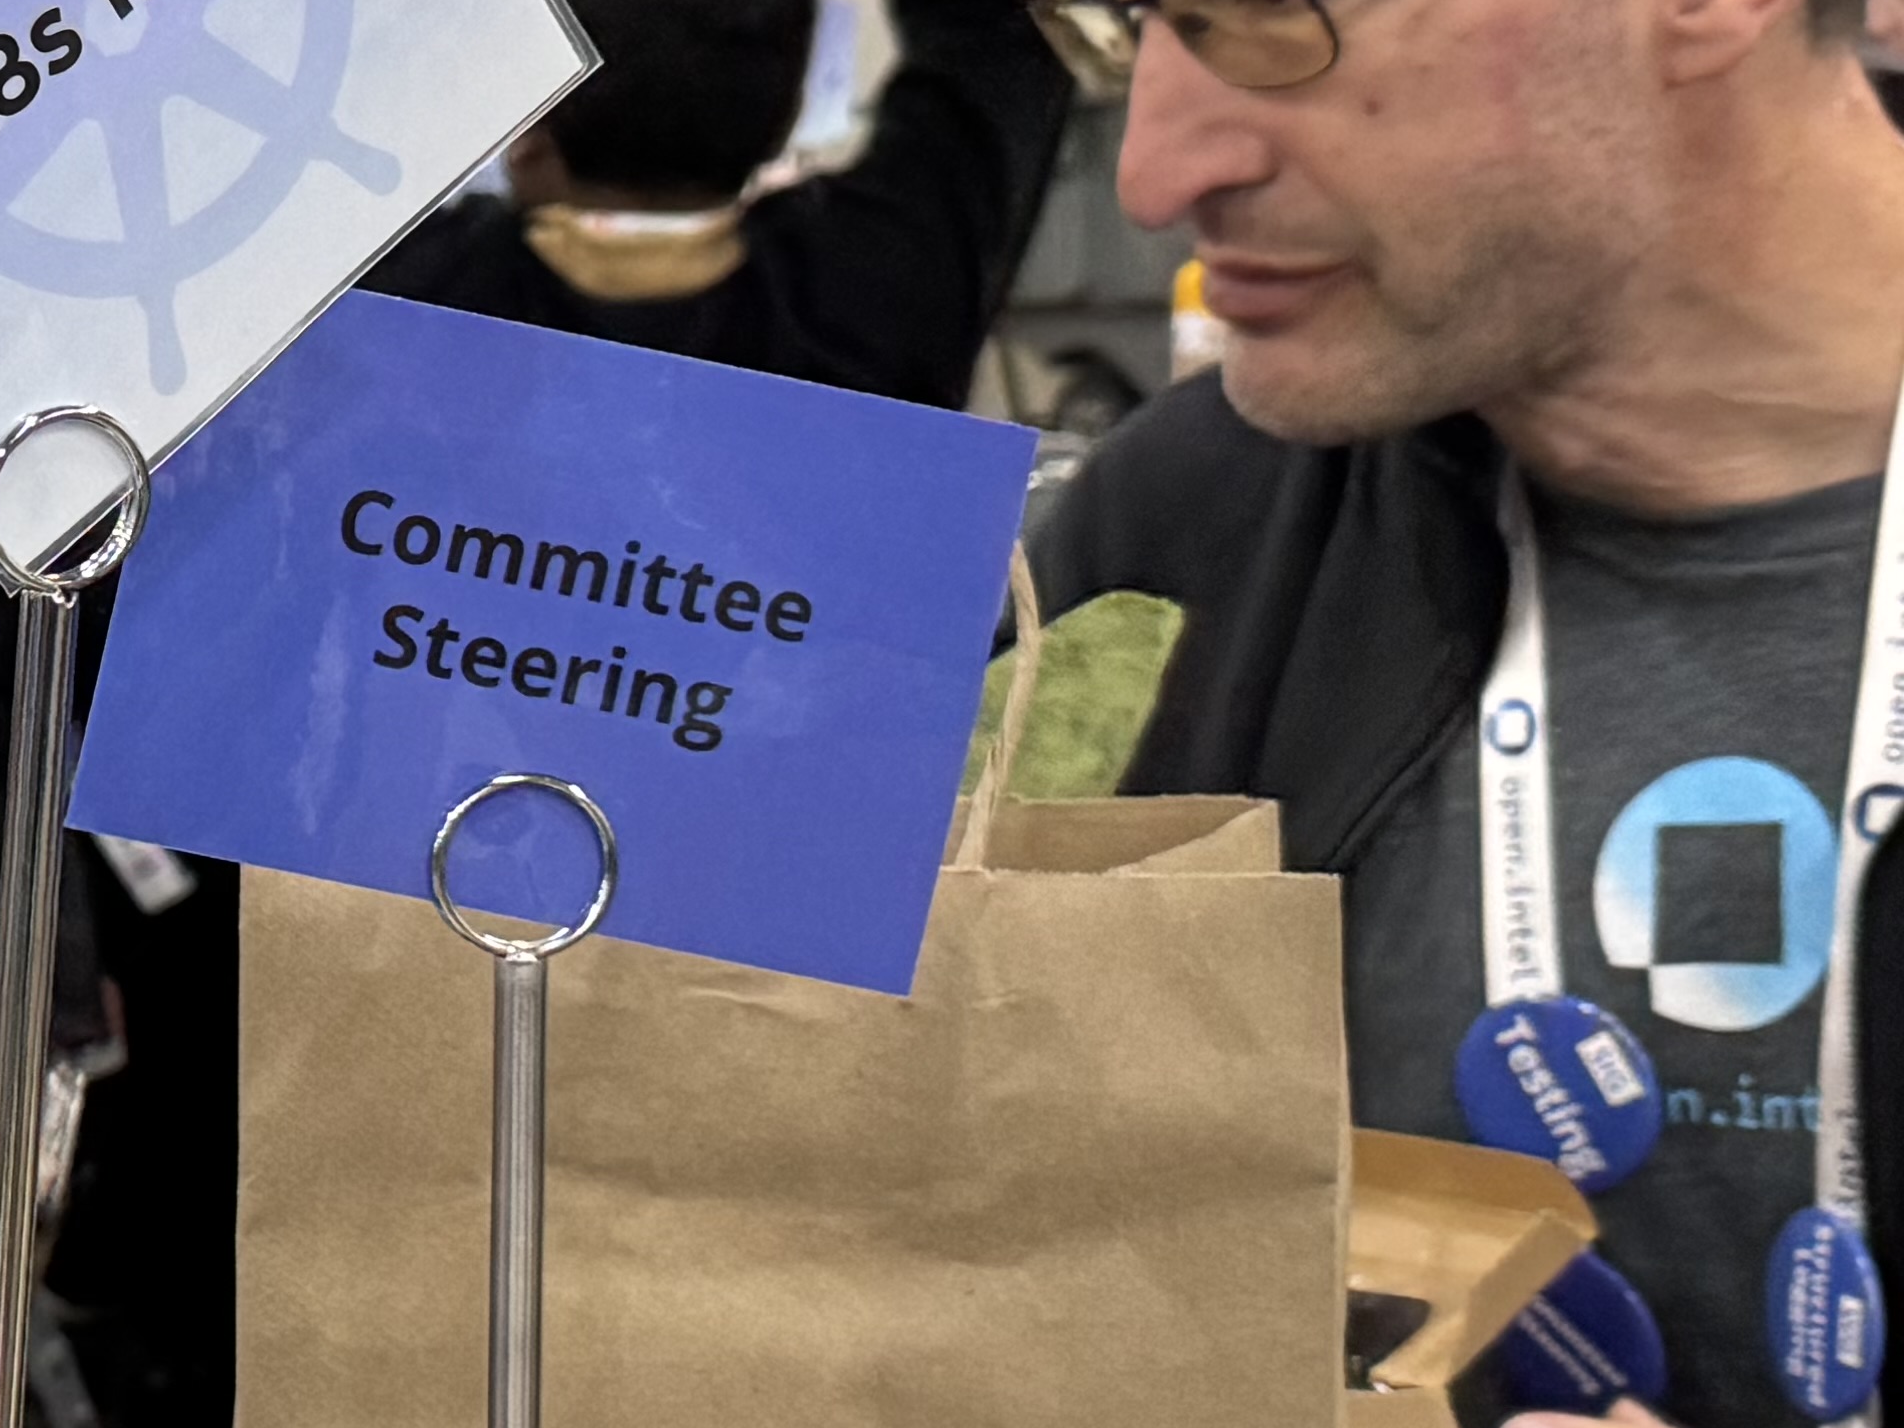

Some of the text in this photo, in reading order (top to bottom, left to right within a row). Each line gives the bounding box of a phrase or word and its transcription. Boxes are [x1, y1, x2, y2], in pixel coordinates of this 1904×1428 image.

[340, 489, 814, 643] Committee
[372, 603, 733, 752] Steering
[1495, 1013, 1606, 1179] Testing
